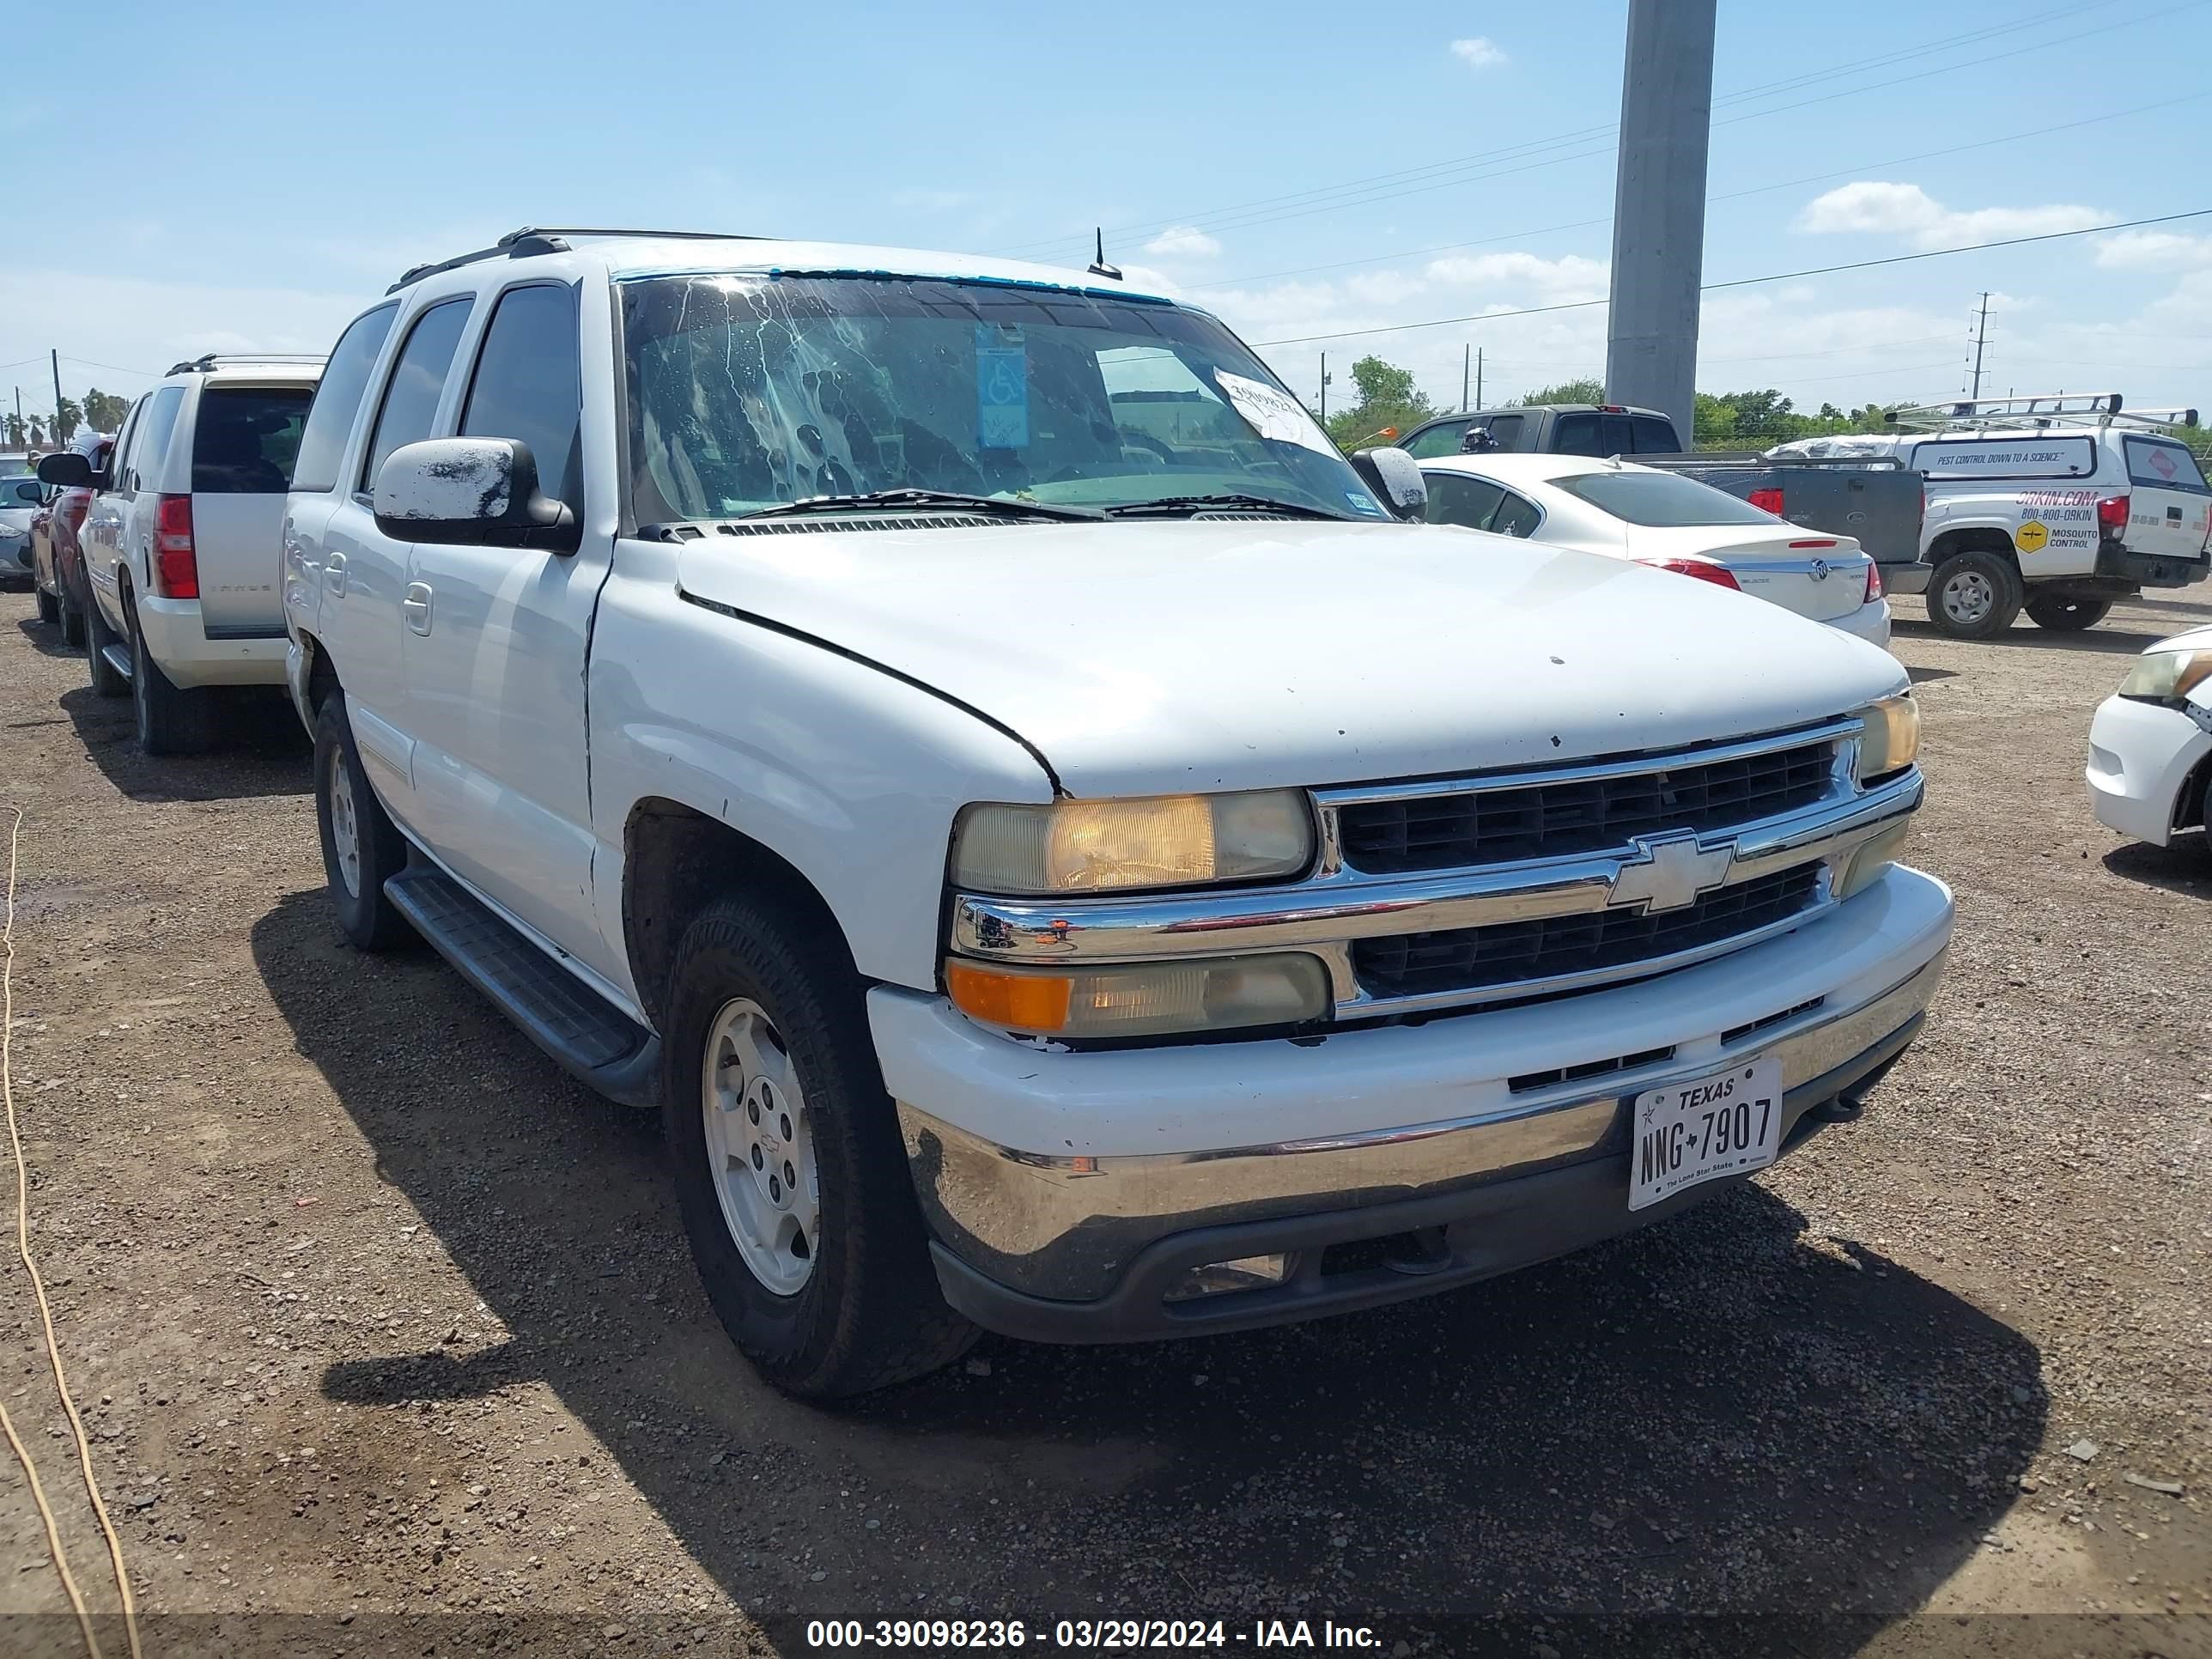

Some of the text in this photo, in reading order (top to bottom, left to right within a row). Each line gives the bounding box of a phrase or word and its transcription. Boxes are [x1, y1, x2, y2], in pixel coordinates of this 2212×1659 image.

[1937, 456, 1954, 465] PEST
[1955, 454, 1986, 465] CONTROL
[1988, 453, 2013, 464] DOWN
[2013, 453, 2022, 463] TO
[2015, 490, 2099, 506] ORKIN.COM
[2021, 508, 2093, 521] 800-800-ORKIN
[2051, 529, 2098, 538] MOSQUITO
[2050, 539, 2088, 548] CONTROL
[1679, 1078, 1735, 1110] TEXAS
[1641, 1098, 1771, 1186] NNG 7907
[1667, 1162, 1733, 1188] The Lone Star State
